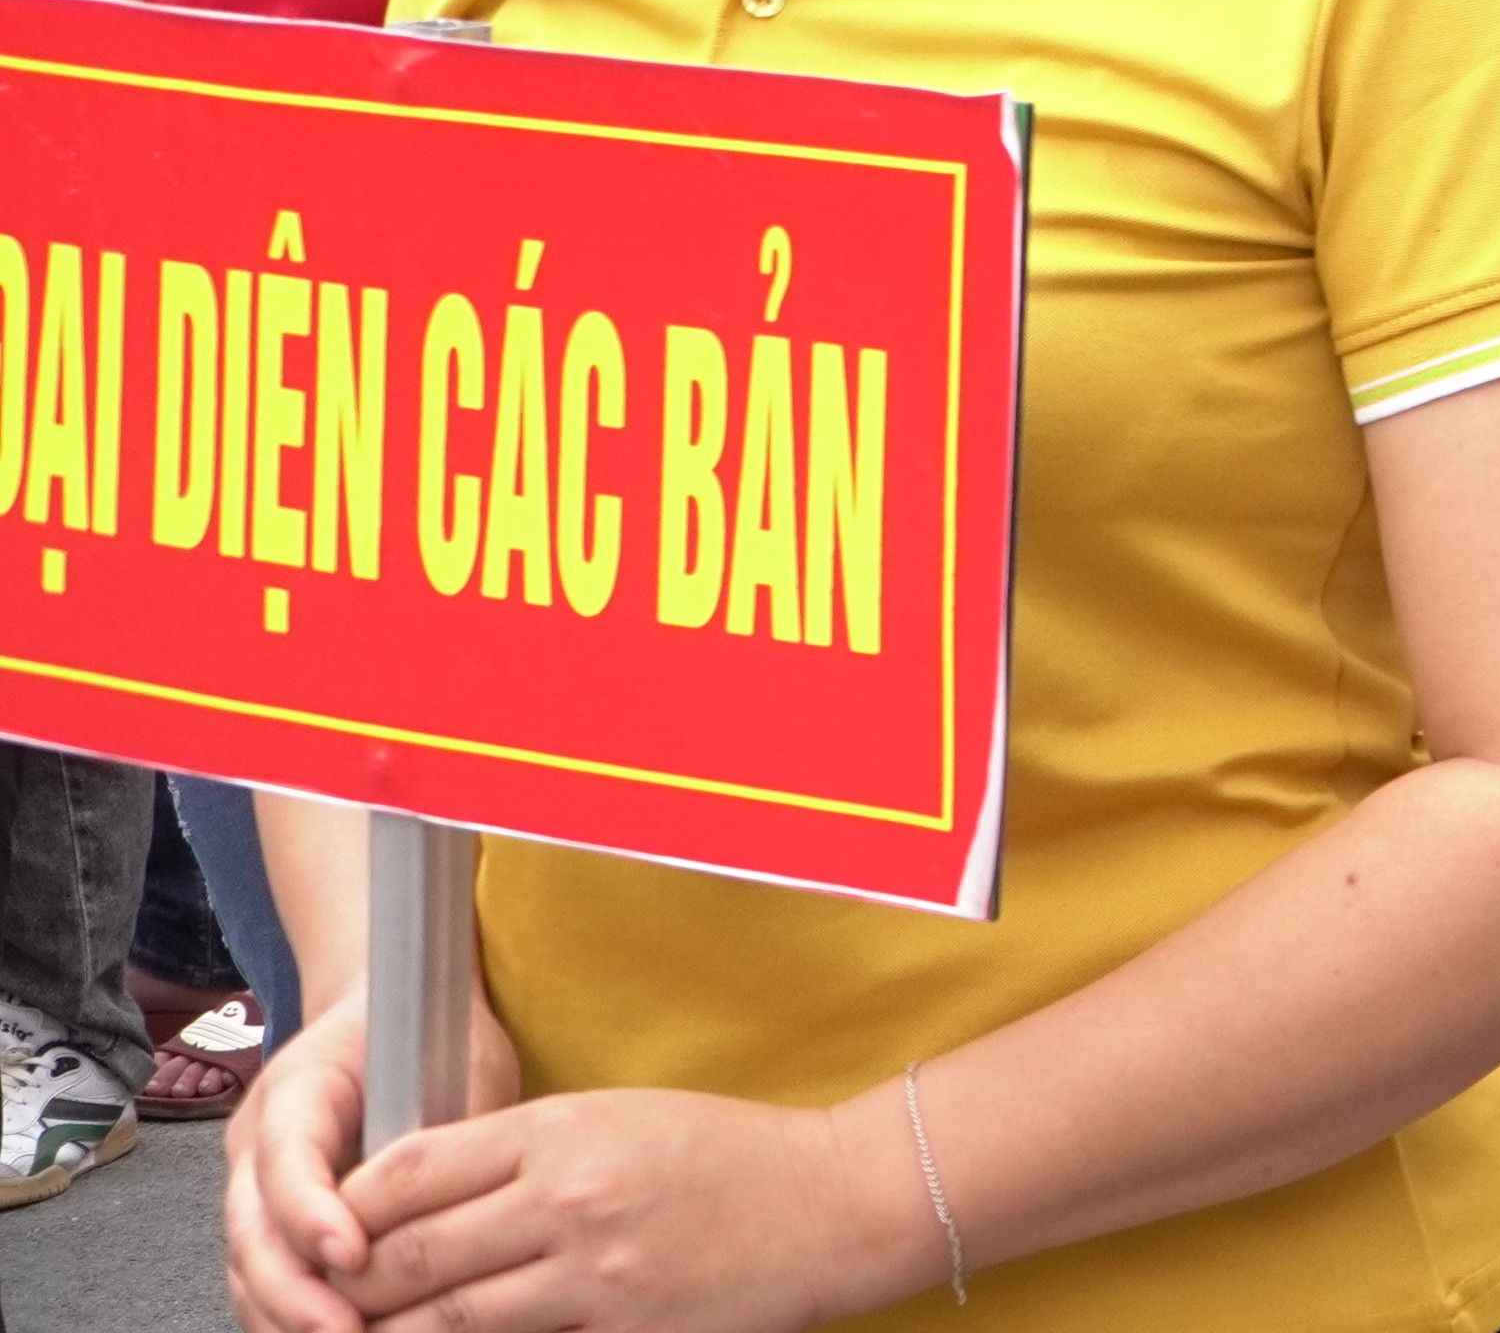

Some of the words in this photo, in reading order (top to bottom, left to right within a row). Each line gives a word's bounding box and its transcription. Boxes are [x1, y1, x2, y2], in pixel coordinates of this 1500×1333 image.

[152, 209, 388, 634] DIỆN
[417, 239, 627, 619] CÁC
[656, 225, 888, 655] BẢN
